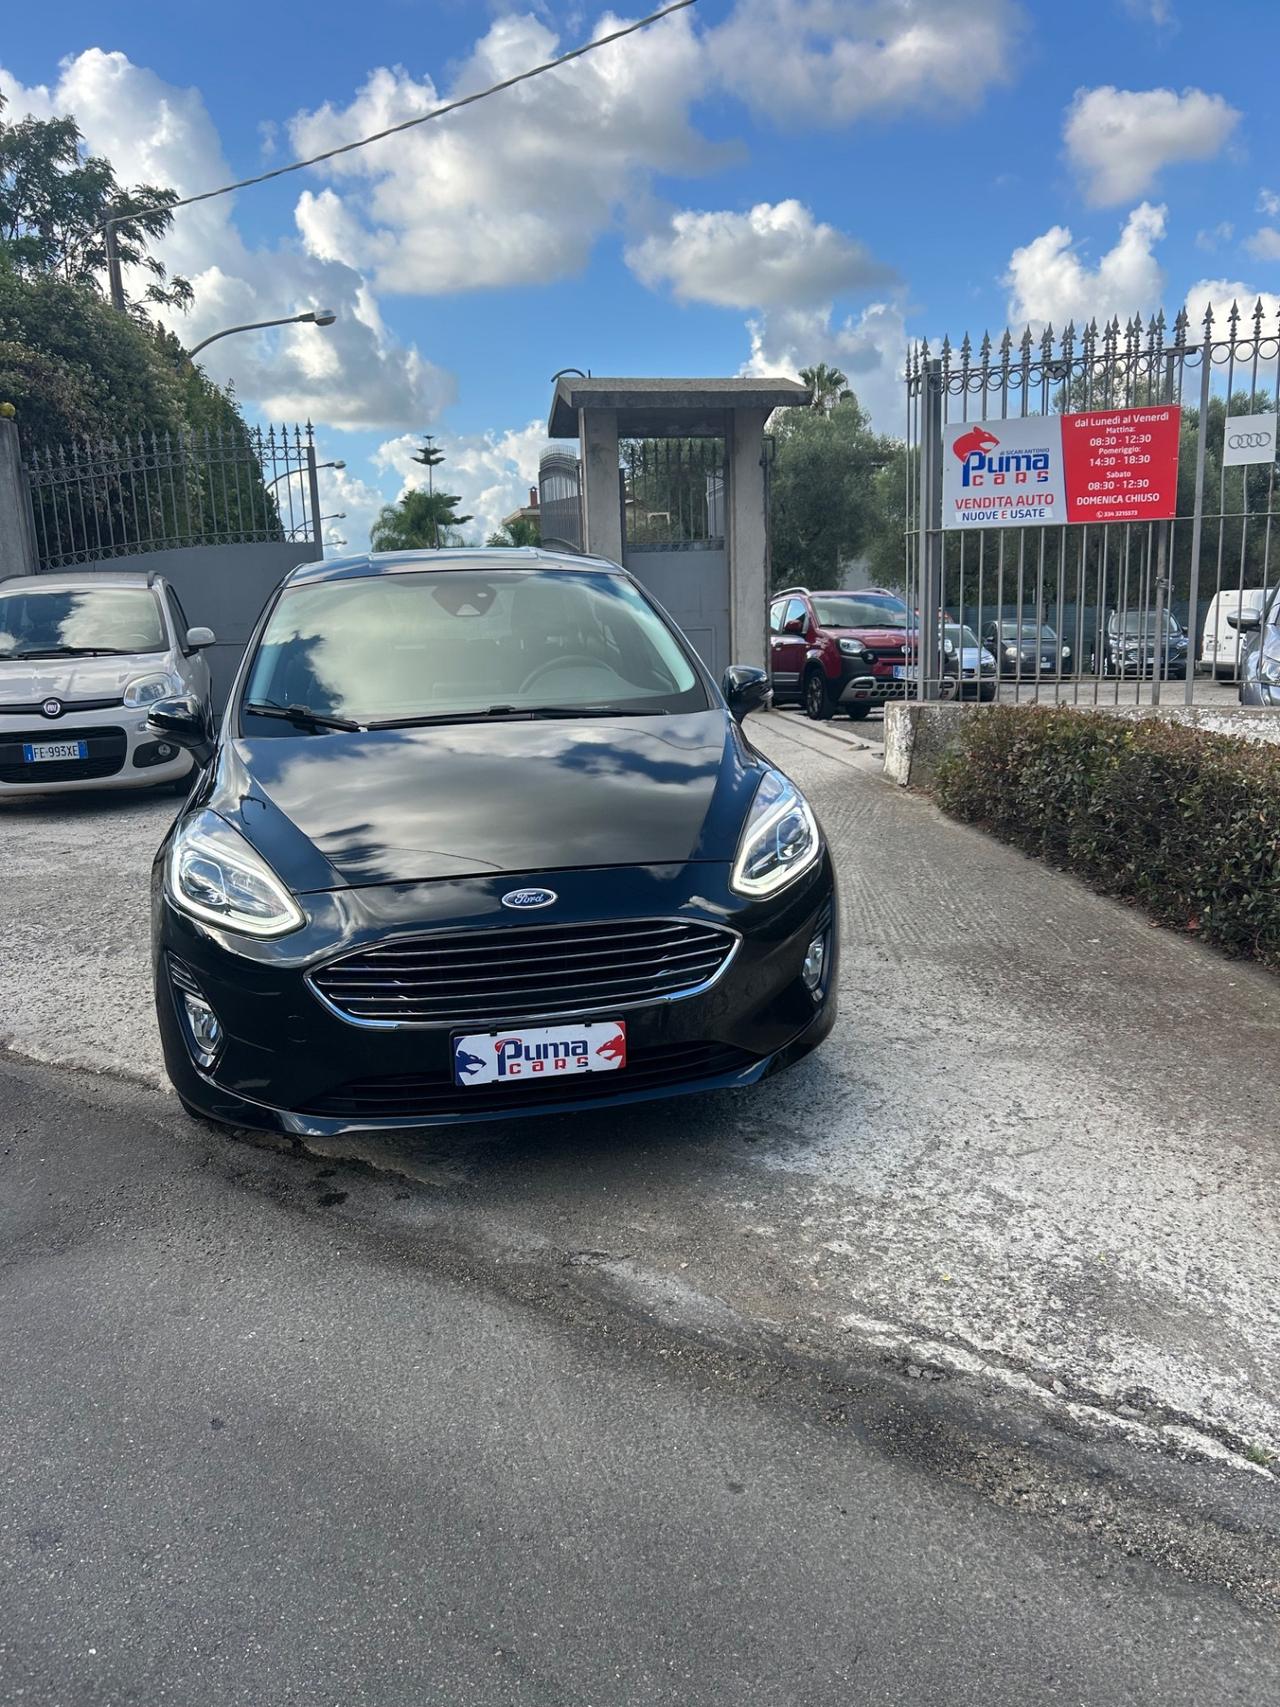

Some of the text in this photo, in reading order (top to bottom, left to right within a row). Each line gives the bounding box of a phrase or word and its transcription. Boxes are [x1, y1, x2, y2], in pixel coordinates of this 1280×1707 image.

[1075, 419, 1088, 428] dal
[1122, 414, 1131, 424] al
[1133, 412, 1169, 423] Venerdì
[1106, 426, 1136, 434] Mattina:
[1090, 437, 1117, 447] 08:30
[1125, 434, 1152, 444] 12:30
[1099, 446, 1141, 455] Pomeriggio:
[1090, 456, 1116, 467] 14:30
[1124, 454, 1151, 464] 18:30
[962, 451, 1050, 487] Puma
[1106, 471, 1132, 479] Sabato
[1088, 481, 1114, 491] 08:30
[1123, 479, 1149, 488] 12:30
[955, 493, 1054, 510] VENDITA AUTO
[1076, 493, 1160, 506] DOMENICA CHIUSO
[962, 508, 1045, 521] NUOVE E USATE
[514, 892, 544, 905] Ford
[496, 1039, 589, 1076] Puma
